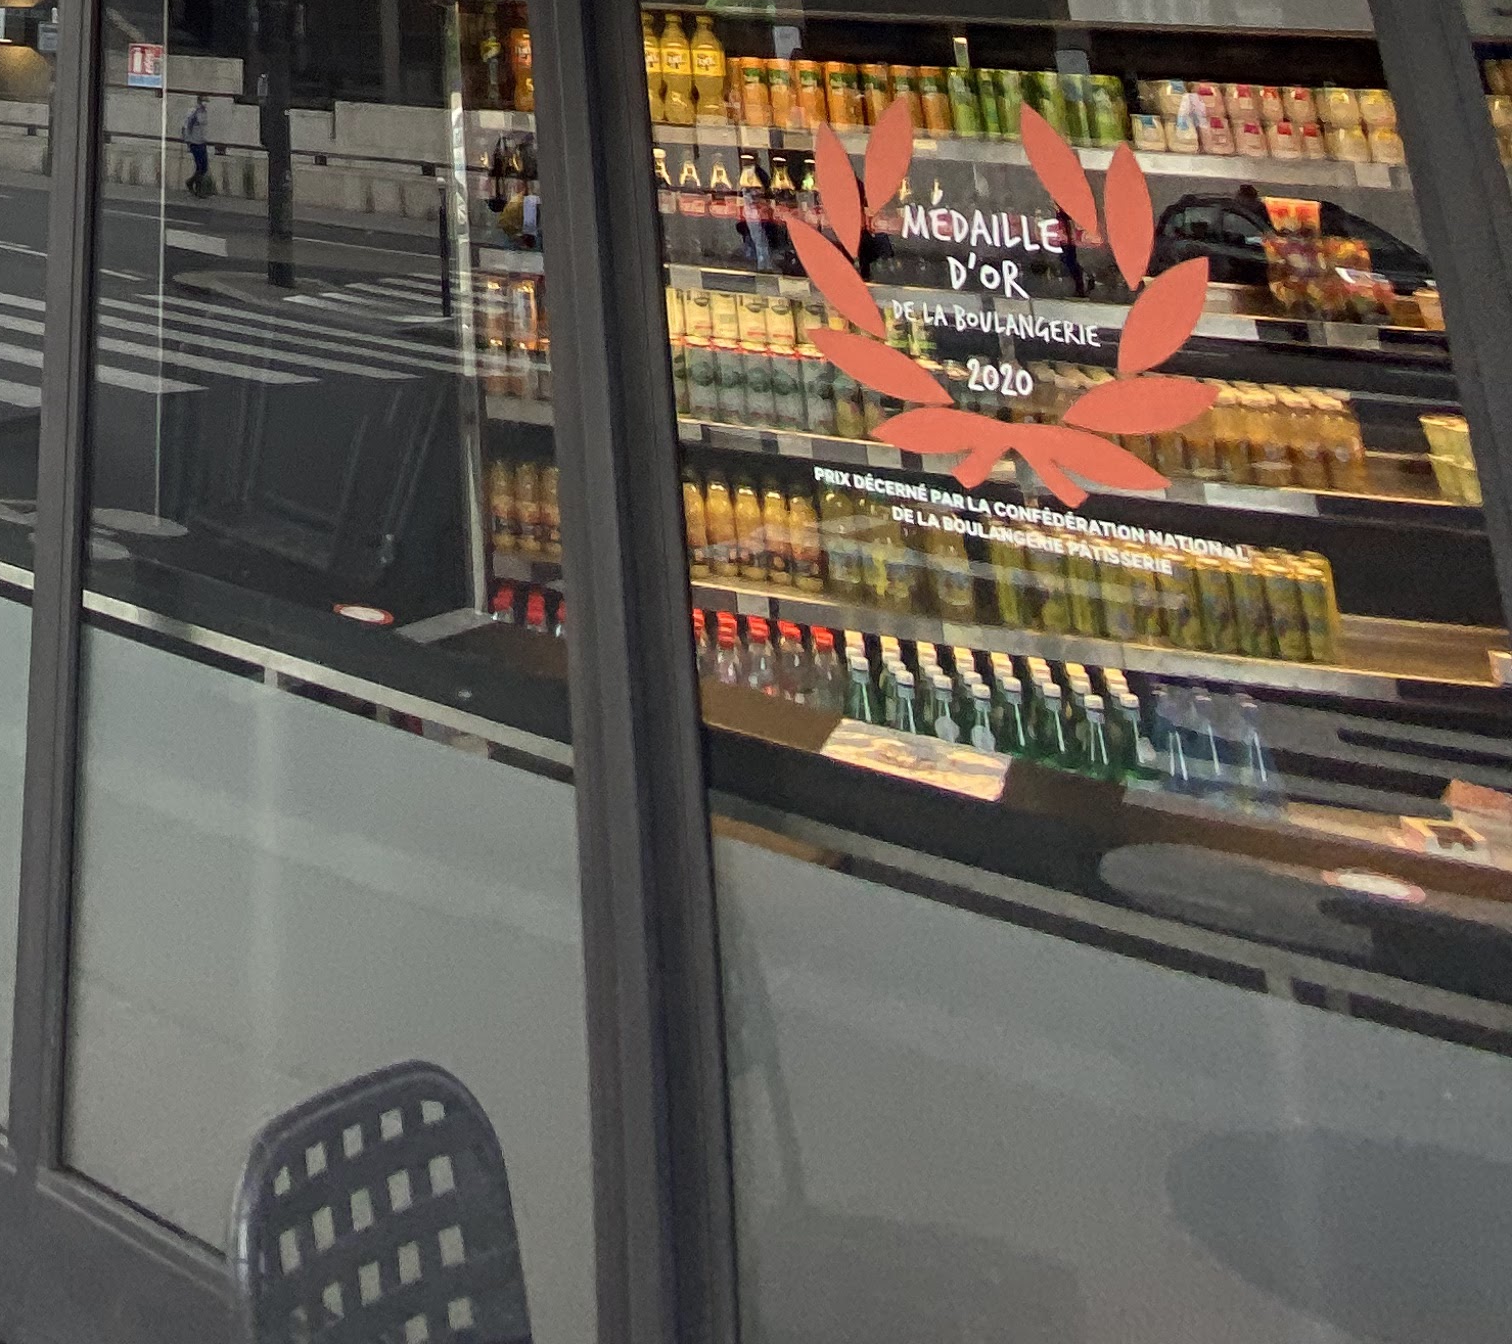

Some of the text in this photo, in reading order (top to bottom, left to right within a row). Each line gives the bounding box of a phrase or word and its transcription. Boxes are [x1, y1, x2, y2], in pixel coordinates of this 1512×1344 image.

[901, 189, 1064, 254] MÉDAILLE
[946, 252, 1031, 299] D'OR
[891, 299, 1102, 348] DE LA BOULANGERIE
[966, 357, 1033, 397] 2020
[813, 465, 852, 488] PRIX
[853, 473, 929, 502] DÉCERNÉ
[930, 488, 966, 510] PAR
[966, 496, 992, 517] LA
[993, 501, 1145, 543] CONFÉDÉRATION
[890, 504, 915, 525] DE
[916, 510, 941, 529] LA
[942, 517, 1065, 554] BOULANGERIE
